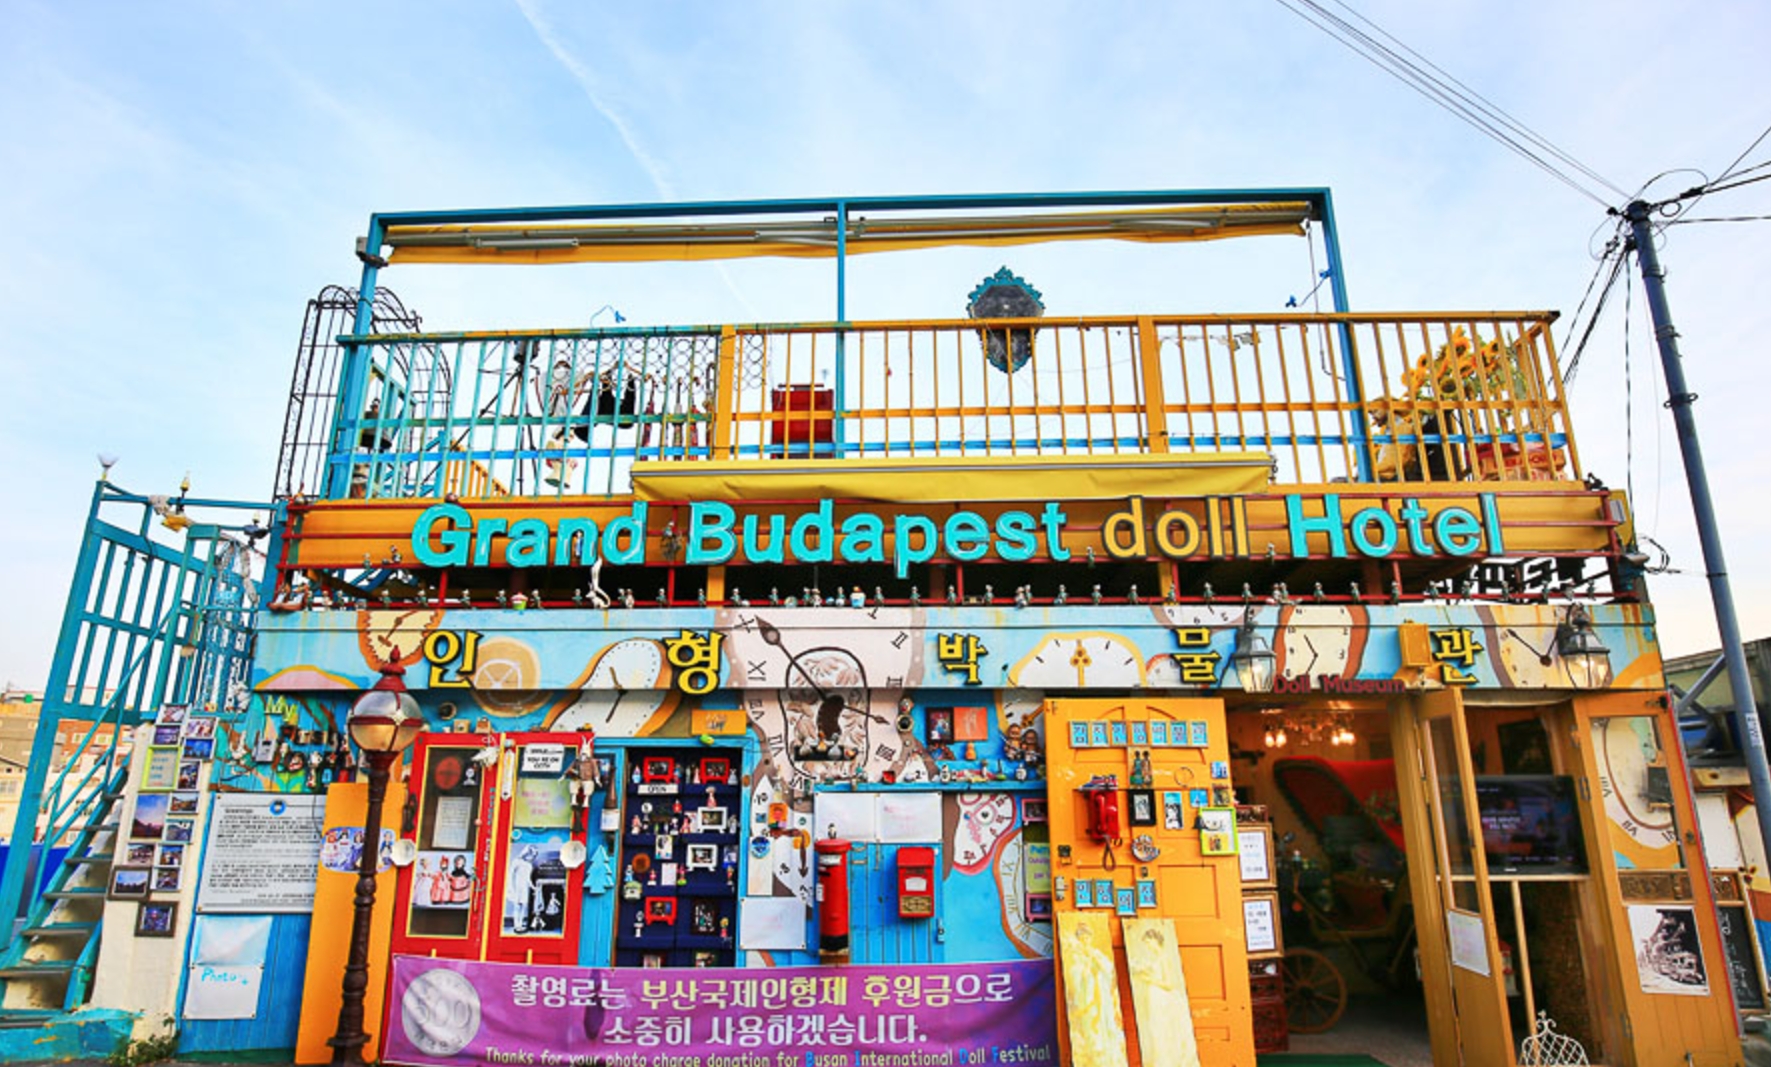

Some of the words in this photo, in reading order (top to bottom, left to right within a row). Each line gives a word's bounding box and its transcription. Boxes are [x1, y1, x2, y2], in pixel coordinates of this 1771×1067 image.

[411, 500, 648, 568] Grand
[686, 498, 1070, 579] Budapest
[1102, 496, 1250, 559] doll
[1284, 492, 1504, 558] Hotel
[421, 629, 484, 690] 인
[662, 628, 726, 694] 형
[937, 632, 989, 686] 박
[1173, 626, 1221, 686] 물
[1432, 630, 1484, 685] 관
[1273, 674, 1311, 694] Doll
[1319, 673, 1406, 694] Museum
[511, 973, 628, 1010] 촬영료는
[640, 974, 847, 1011] 부산국제인형제
[862, 973, 1013, 1008] 후원금으로
[603, 1015, 691, 1047] 소중히
[705, 1013, 927, 1047] 사용하겠습니다.
[485, 1046, 535, 1065] Thanks
[540, 1049, 562, 1066] for
[569, 1053, 600, 1067] your
[606, 1053, 647, 1067] photo
[653, 1052, 702, 1067] charge
[708, 1051, 770, 1067] donation
[777, 1051, 800, 1067] for
[805, 1051, 848, 1066] Busan
[854, 1048, 954, 1066] International
[959, 1048, 986, 1065] Doll
[991, 1043, 1052, 1062] Festival
